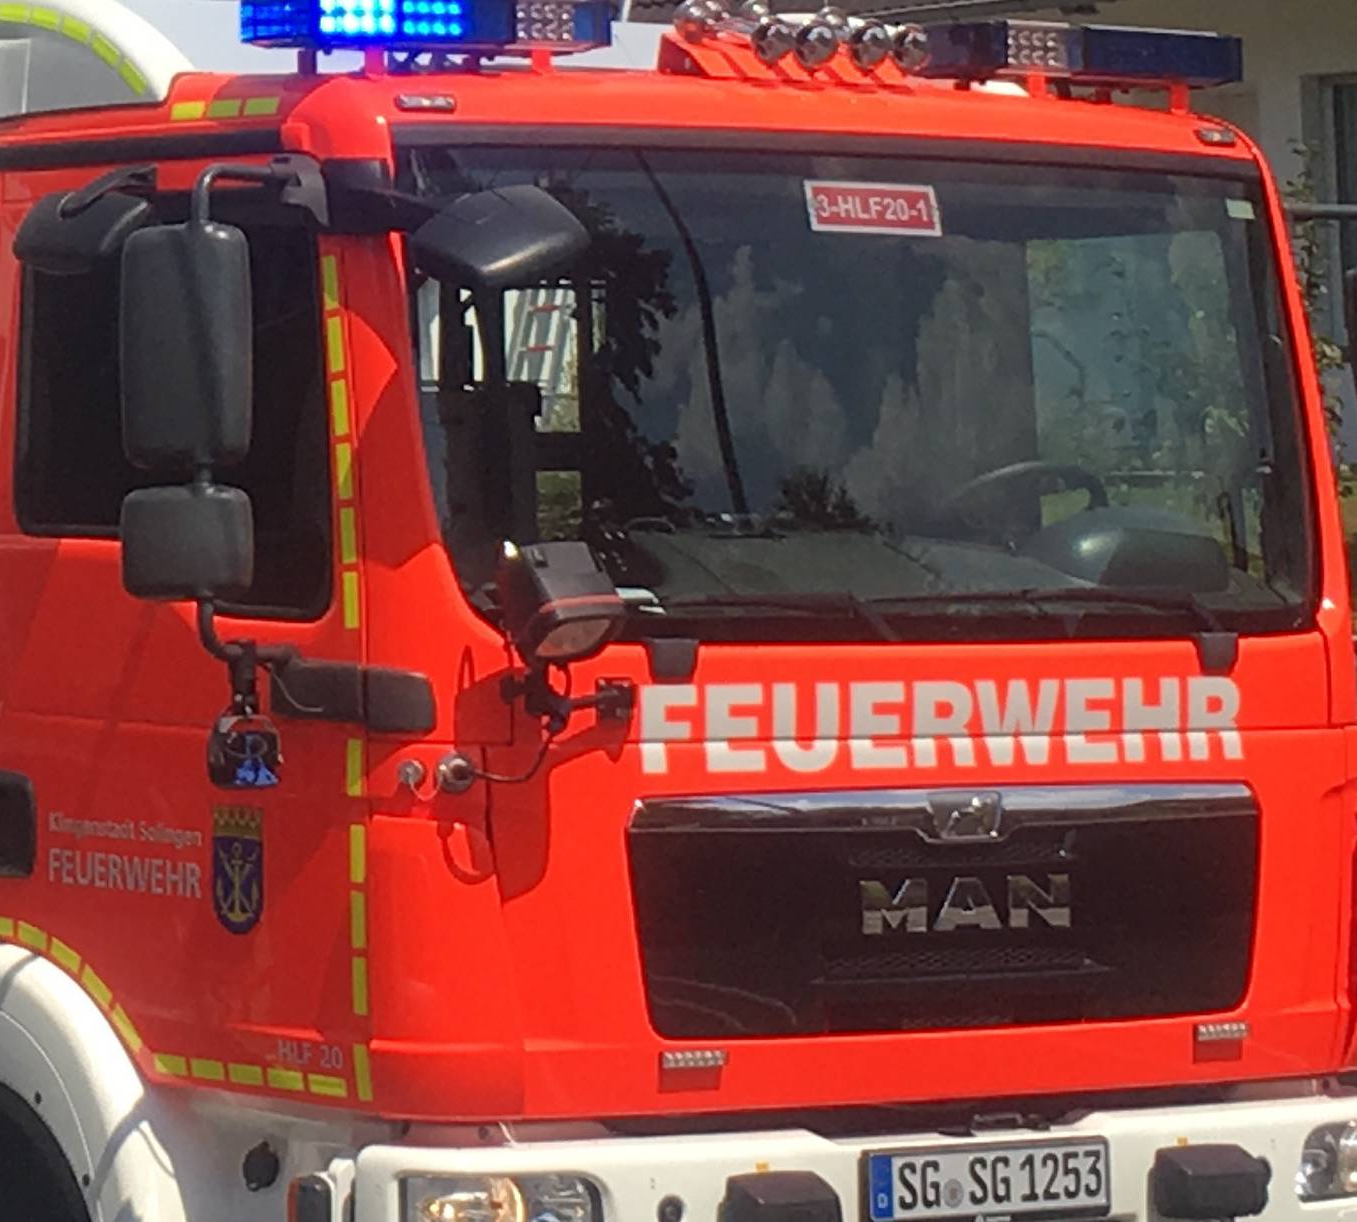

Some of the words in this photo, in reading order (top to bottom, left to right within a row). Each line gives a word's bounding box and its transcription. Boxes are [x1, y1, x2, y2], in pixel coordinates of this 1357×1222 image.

[816, 194, 929, 221] 3-HLF20-1
[640, 676, 1244, 774] FEUERWEHR
[49, 812, 135, 840] Klingenstadt
[139, 821, 202, 849] Solingen
[48, 848, 201, 898] FEUERWEHR
[859, 873, 1071, 935] MAN
[278, 1040, 311, 1064] HLF
[321, 1045, 343, 1069] 20
[898, 1160, 941, 1210] SG
[969, 1156, 1011, 1205] SG
[1020, 1150, 1102, 1202] 1253
